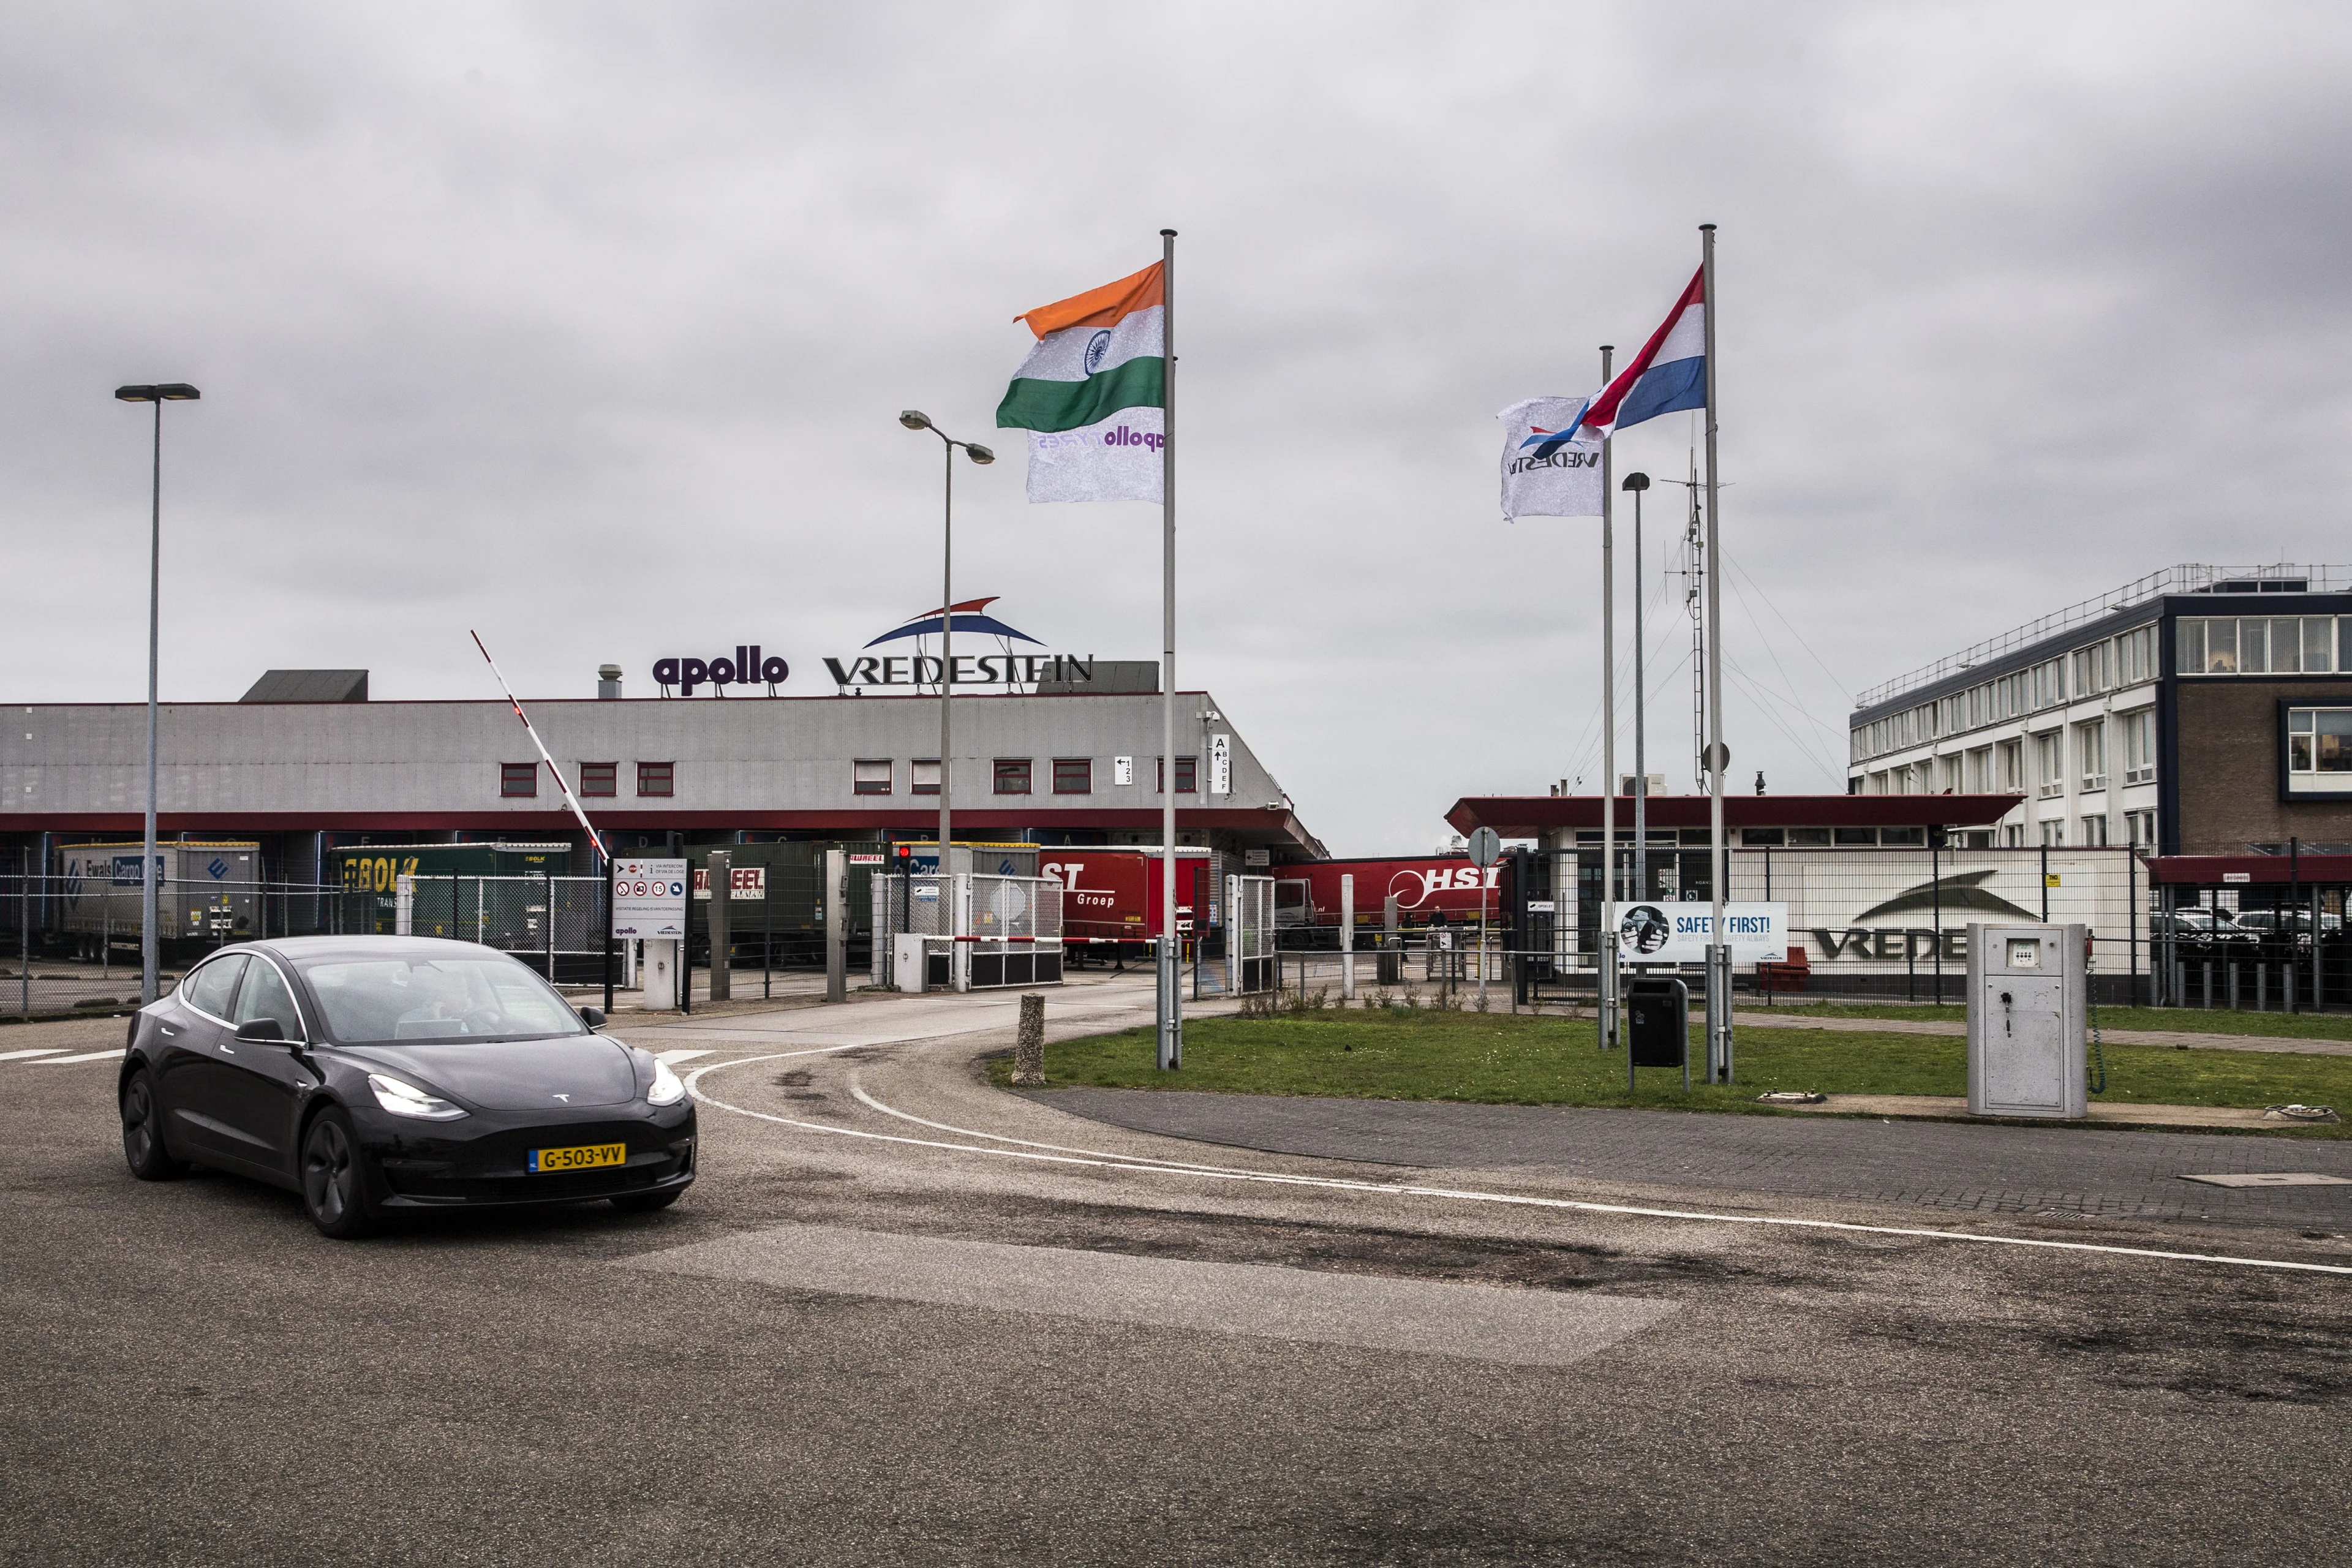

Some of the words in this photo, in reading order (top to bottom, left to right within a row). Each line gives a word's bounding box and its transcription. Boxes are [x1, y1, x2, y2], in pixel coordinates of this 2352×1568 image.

[652, 645, 789, 696] apollo
[822, 654, 1093, 685] VREDESTEIN
[1216, 738, 1225, 748] A
[639, 836, 647, 848] D
[87, 860, 111, 878] Ewals
[115, 859, 140, 884] Cargo
[1042, 863, 1084, 890] ST
[1423, 867, 1500, 888] HST
[1077, 894, 1114, 908] Groep
[616, 927, 637, 936] apollo
[1730, 917, 1770, 933] FIRST!
[1811, 928, 1967, 959] VREDE
[545, 1146, 621, 1167] G-503-VV
